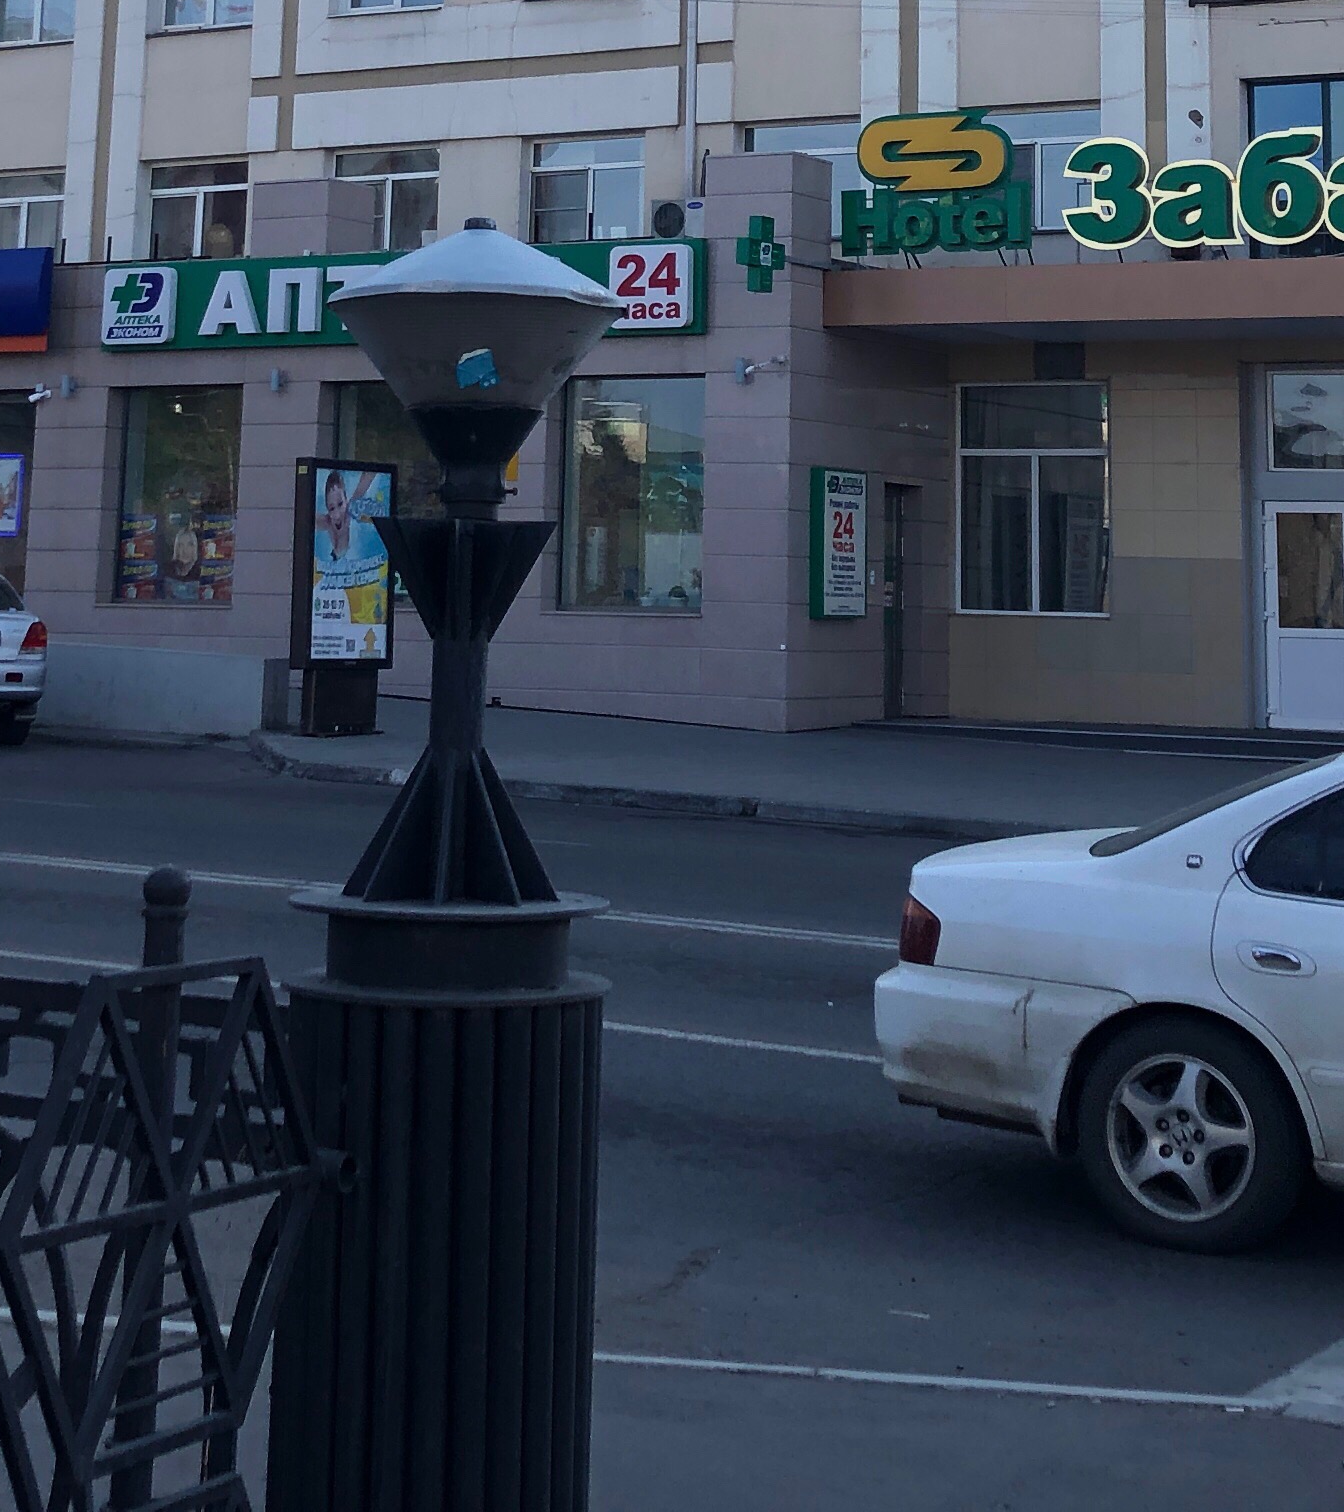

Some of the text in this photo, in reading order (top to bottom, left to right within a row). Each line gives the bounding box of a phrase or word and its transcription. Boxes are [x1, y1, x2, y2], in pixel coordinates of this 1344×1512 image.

[841, 181, 1032, 257] Hotel
[617, 252, 681, 297] 24
[114, 315, 160, 325] АПТЕКА
[110, 328, 158, 338] ЭКОНОМ
[833, 511, 854, 539] 24
[832, 541, 854, 553] часа
